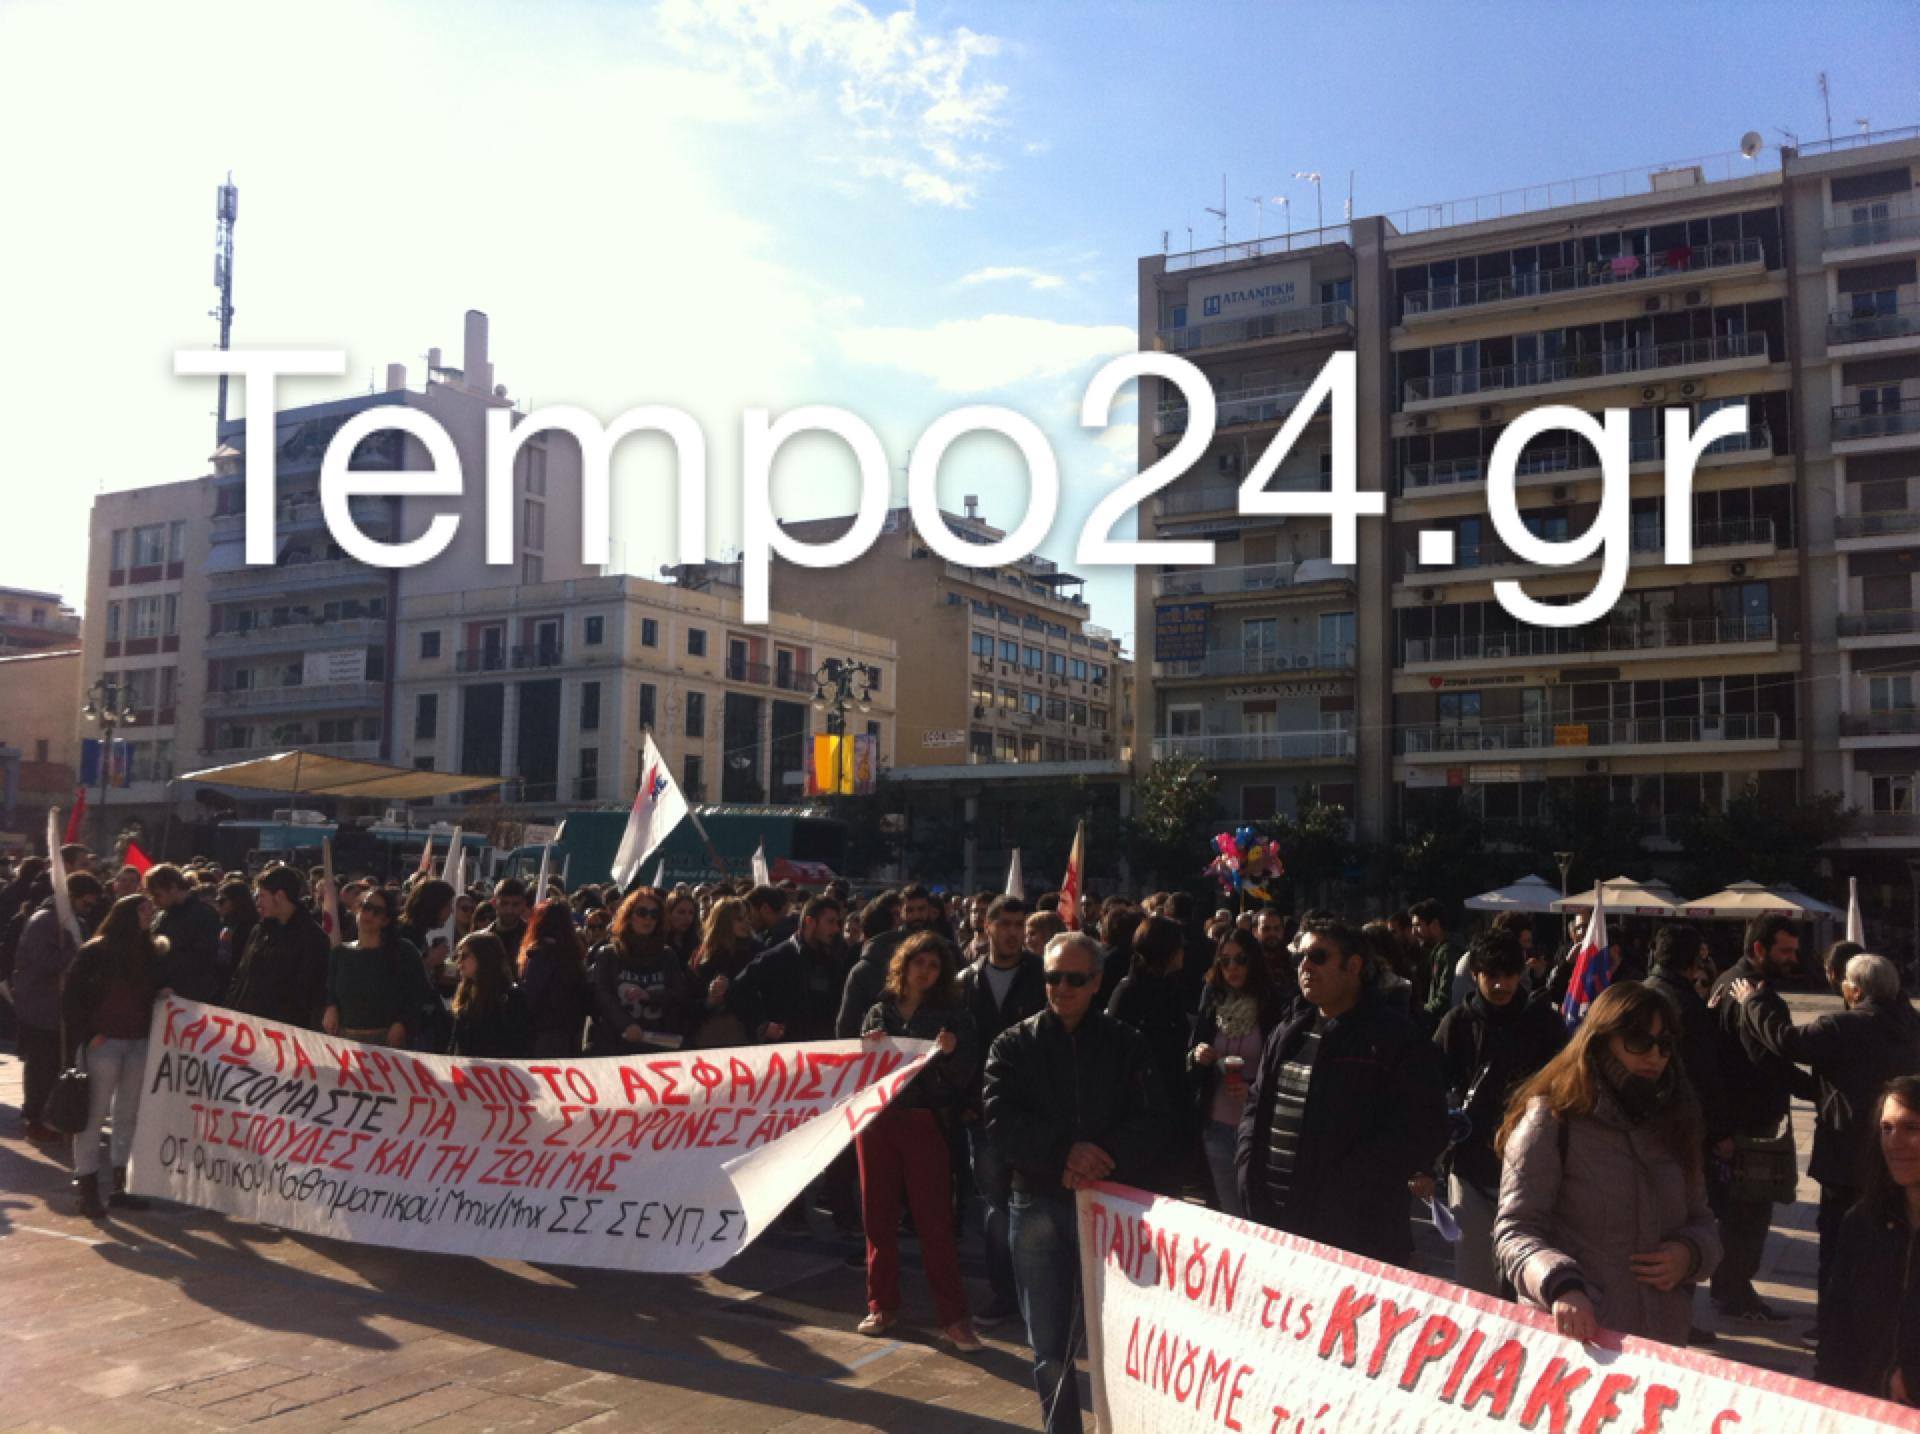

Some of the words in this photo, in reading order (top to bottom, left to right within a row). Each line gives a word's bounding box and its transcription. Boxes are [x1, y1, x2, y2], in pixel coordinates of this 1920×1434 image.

[163, 1001, 256, 1065] ΚΑΤΩ
[263, 1028, 317, 1081] ΤΑ
[326, 1044, 443, 1100] ΧΕΡΙΑ
[450, 1065, 528, 1102] ΑΠΟ
[528, 1065, 598, 1105] ΤΟ
[619, 1049, 926, 1105] ΑΣΦΑΛΙΣΤΙΚ
[190, 1103, 226, 1145] ΤΙΣ
[227, 1111, 373, 1171] ΣΠΟΥΔΕΣ
[365, 1137, 428, 1181] ΚΑΙ
[429, 1145, 481, 1185] ΤΗ
[547, 1151, 632, 1194] ΜΑΣ
[398, 1096, 459, 1141] ΓΙΑ
[480, 1103, 538, 1146] ΤΙΣ
[543, 1105, 757, 1150] ΣΥΓΧΡΟΝΕΣ
[547, 1195, 606, 1236] ΣΣ
